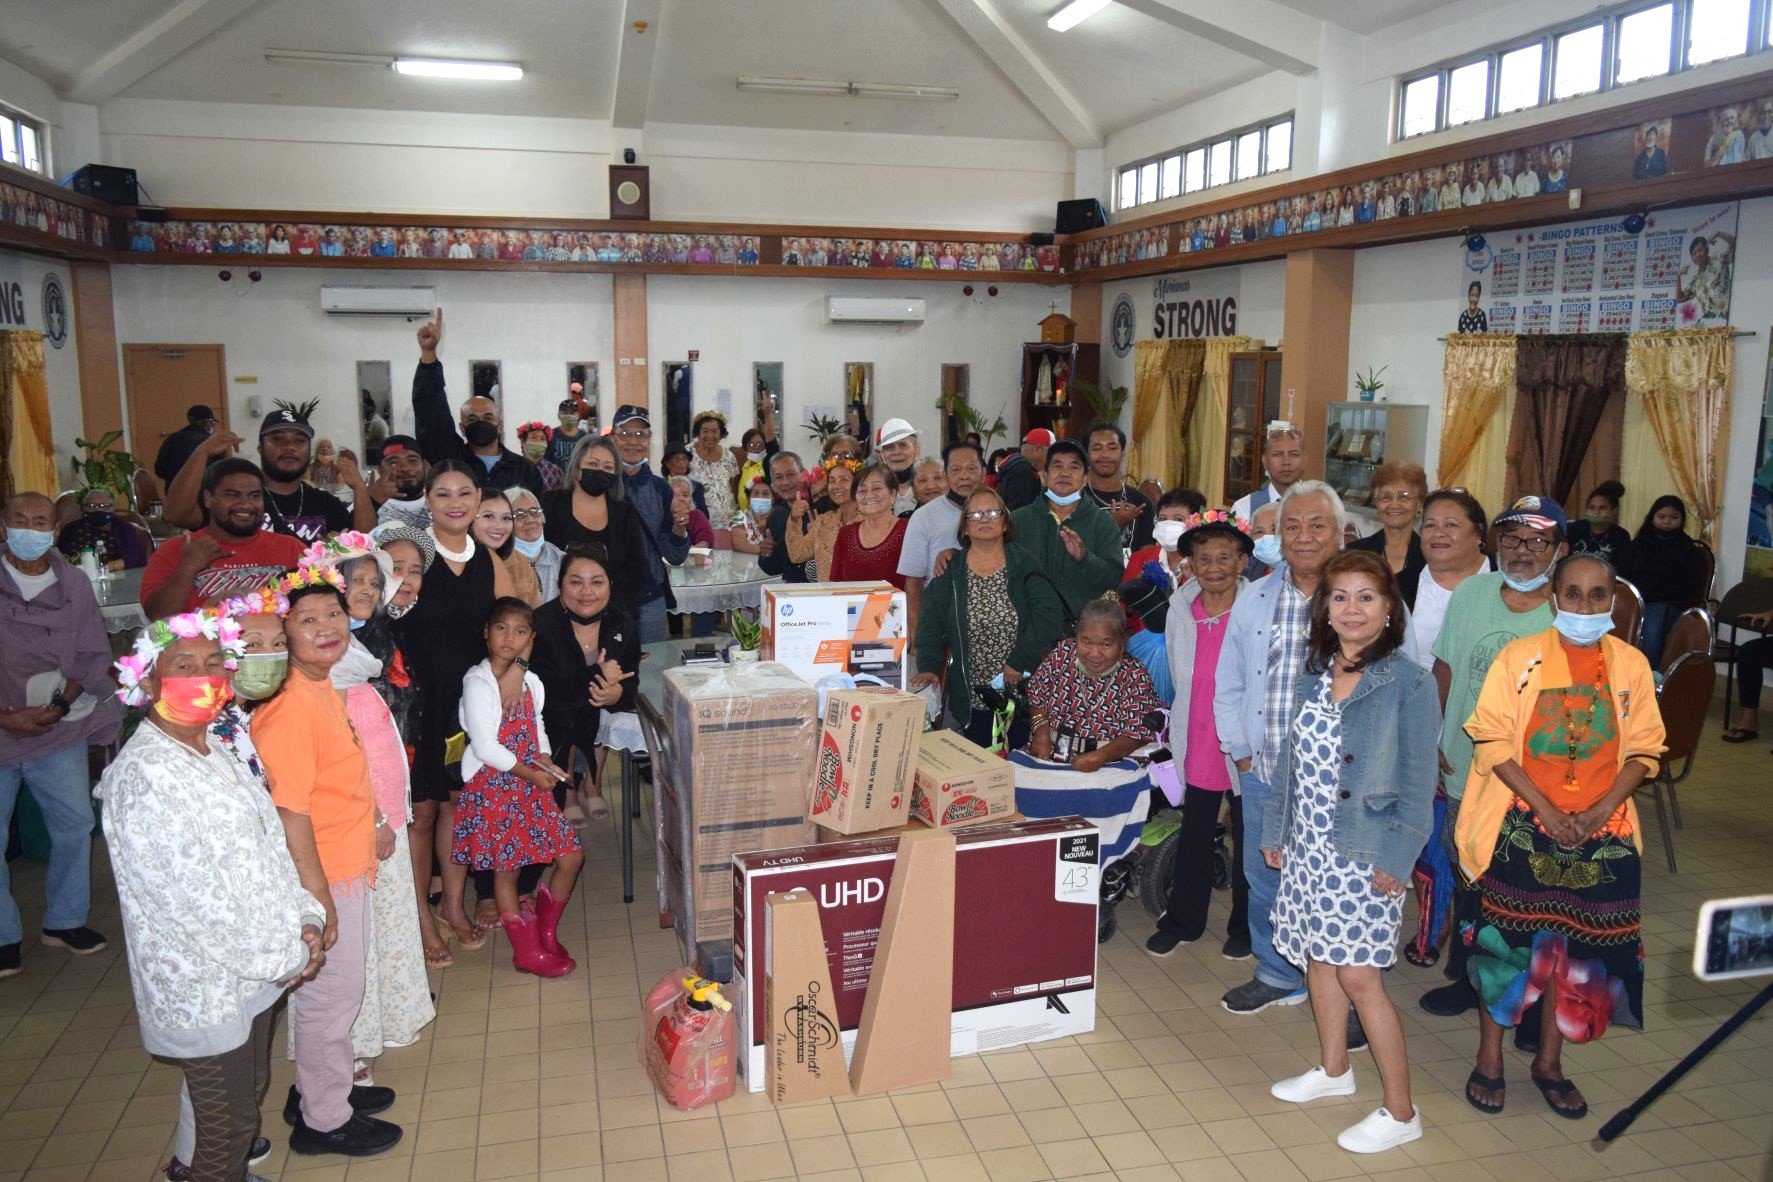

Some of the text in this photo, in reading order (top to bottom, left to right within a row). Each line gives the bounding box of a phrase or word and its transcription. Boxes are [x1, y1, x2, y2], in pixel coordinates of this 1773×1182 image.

[1573, 223, 1624, 237] PATTERNS
[1607, 241, 1635, 251] BINGO
[1649, 237, 1680, 247] BINGO
[1529, 250, 1554, 259] BINGO
[1567, 246, 1593, 256] BINGO
[1496, 254, 1518, 262] BINGO
[1154, 279, 1191, 302] Marianas
[1562, 304, 1588, 312] BINGO
[1602, 302, 1630, 311] BINGO
[1644, 300, 1674, 309] BINGO
[1492, 307, 1514, 315] BINGO
[1525, 306, 1550, 314] BINGO
[1154, 297, 1237, 339] STRONG
[781, 604, 793, 617] hp
[847, 723, 857, 763] NONGSHIM
[819, 747, 832, 790] Noodle
[827, 753, 840, 788] Bowl
[870, 759, 878, 776] COOL
[868, 784, 874, 792] IN
[864, 792, 873, 809] KEEP
[948, 803, 970, 813] Bowl
[946, 810, 975, 821] Noodle
[1064, 850, 1094, 859] NOUVEAU
[763, 856, 804, 866] UHD TV
[820, 877, 885, 908] UHD
[777, 1033, 786, 1046] The
[777, 1048, 786, 1073] Leader
